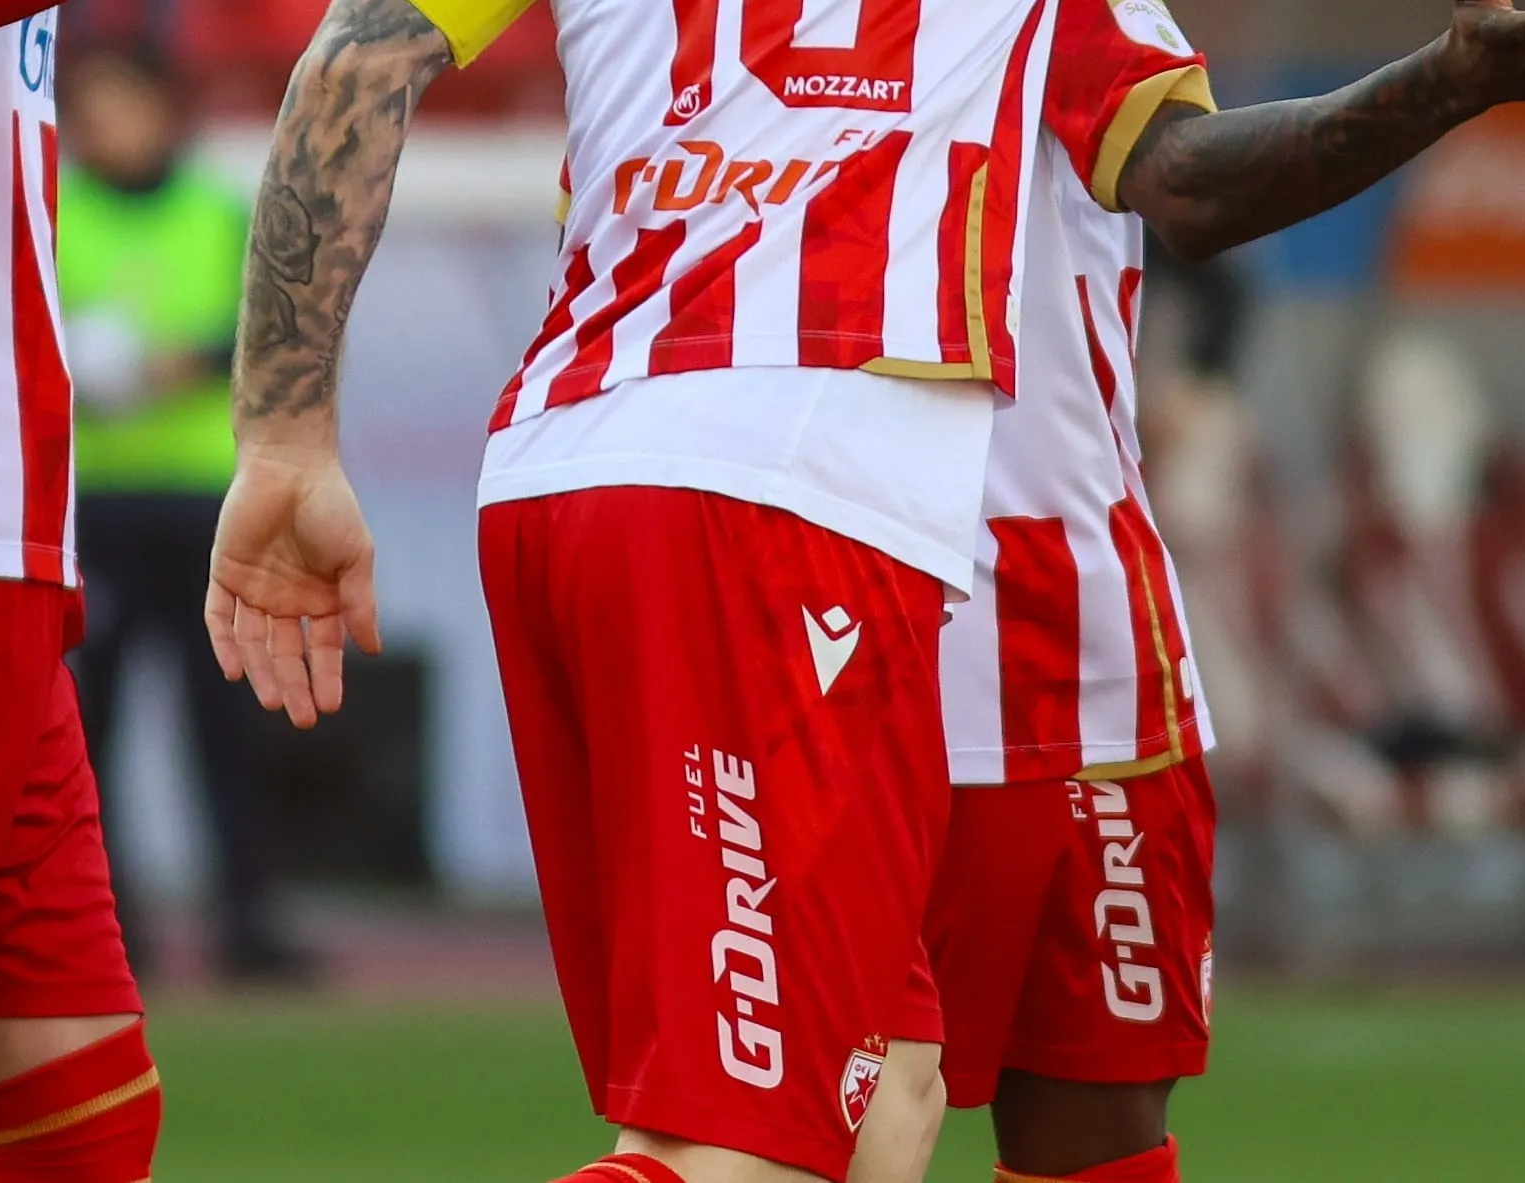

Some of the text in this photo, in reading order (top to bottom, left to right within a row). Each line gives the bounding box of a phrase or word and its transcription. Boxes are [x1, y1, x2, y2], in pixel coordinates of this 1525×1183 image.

[784, 76, 905, 101] MOZZART
[683, 743, 707, 839] FUEL
[1065, 771, 1088, 819] FU
